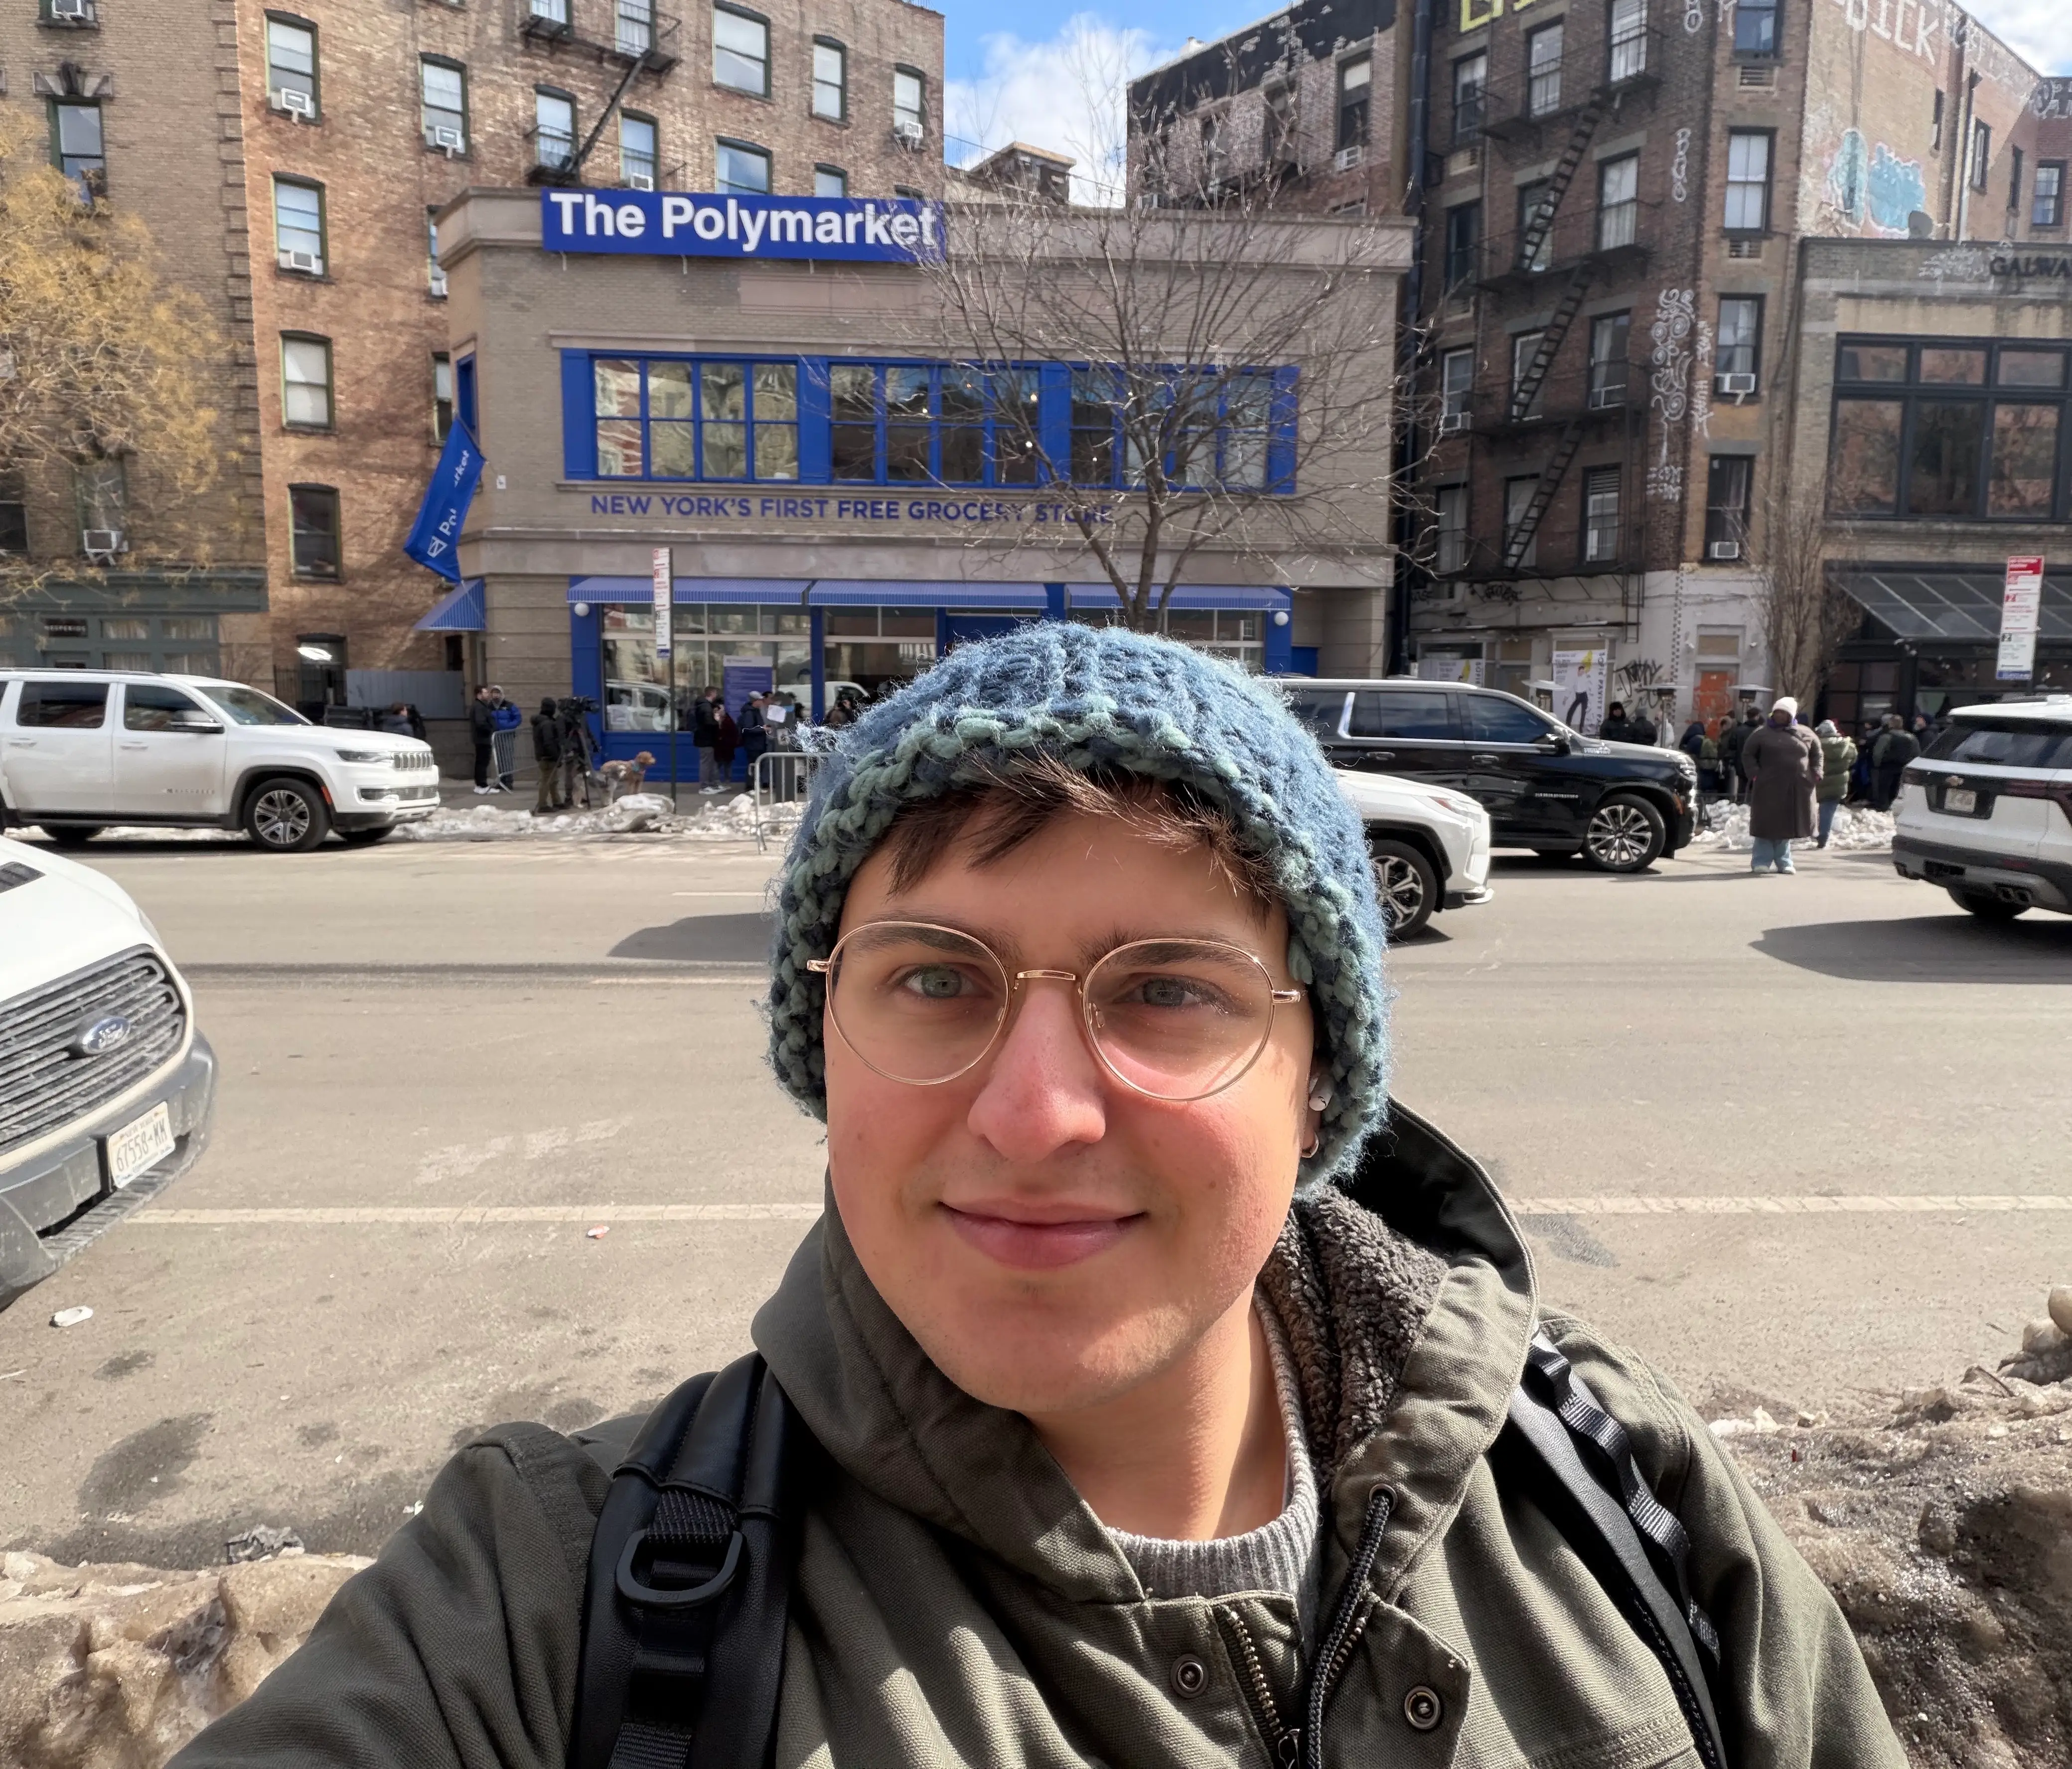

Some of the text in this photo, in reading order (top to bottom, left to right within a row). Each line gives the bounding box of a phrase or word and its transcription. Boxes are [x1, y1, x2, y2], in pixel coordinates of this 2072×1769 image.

[550, 192, 937, 252] The Polymarket
[591, 495, 652, 514] NEW
[660, 496, 751, 517] YORK'S
[760, 498, 828, 518] FIRST
[838, 500, 899, 519] FREE
